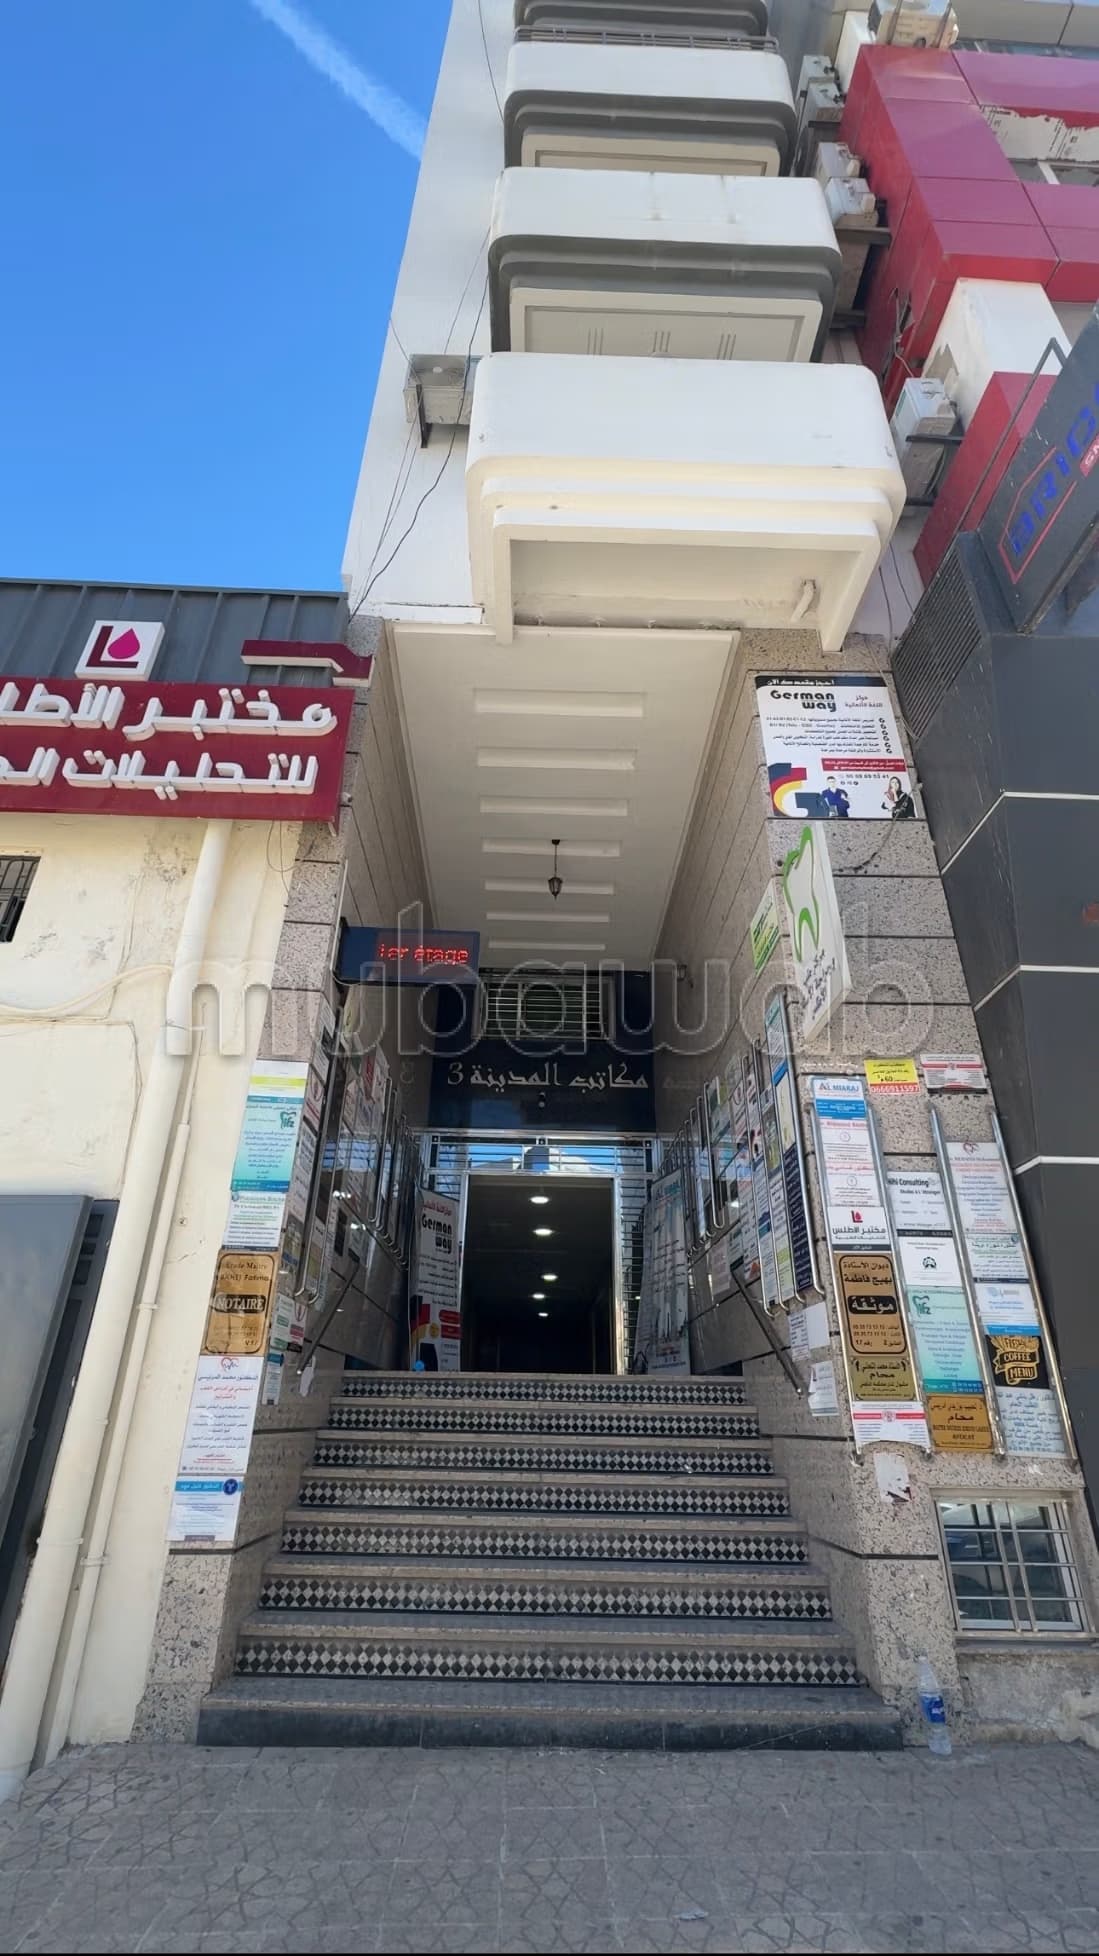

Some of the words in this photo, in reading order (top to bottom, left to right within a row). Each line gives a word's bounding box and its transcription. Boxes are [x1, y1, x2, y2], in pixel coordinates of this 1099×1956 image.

[770, 689, 835, 700] German
[122, 688, 338, 741] مختبر
[802, 701, 837, 712] way
[62, 748, 319, 801] للتحليلات
[447, 1062, 464, 1085] 3
[470, 1060, 561, 1093] المدينة
[568, 1062, 649, 1095] مكاتب
[421, 1213, 452, 1235] German
[435, 1236, 452, 1254] way
[216, 1298, 264, 1310] NOTAIRE
[851, 1295, 894, 1313] موثقة
[1003, 1351, 1032, 1362] COFFEE
[1009, 1367, 1034, 1379] MENU
